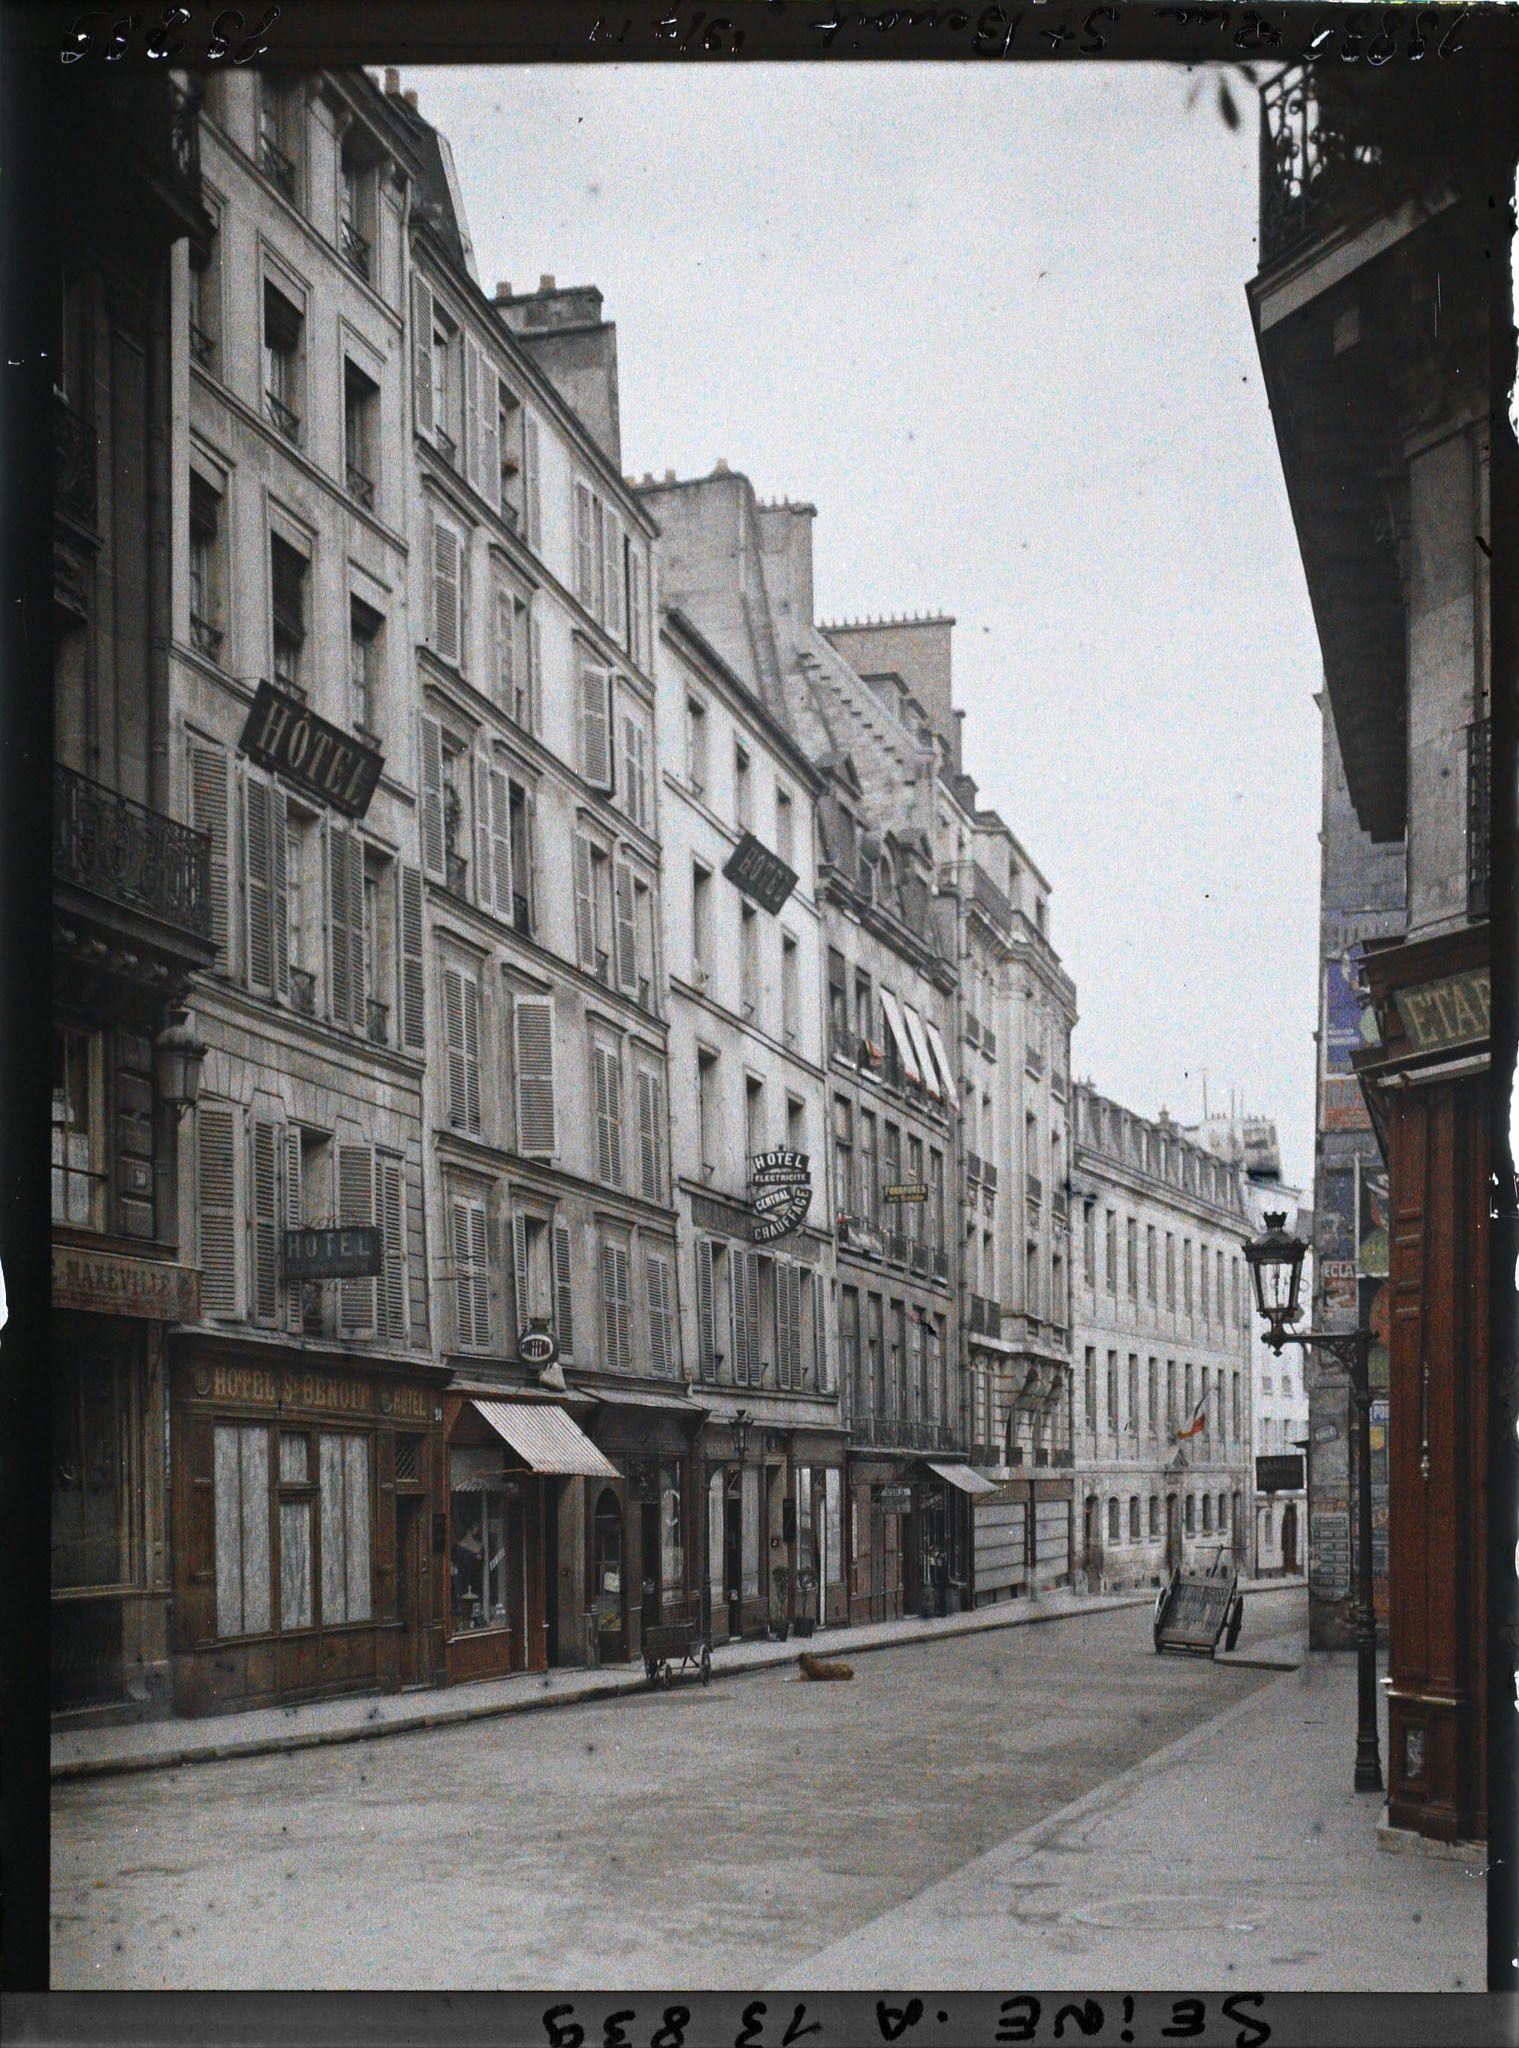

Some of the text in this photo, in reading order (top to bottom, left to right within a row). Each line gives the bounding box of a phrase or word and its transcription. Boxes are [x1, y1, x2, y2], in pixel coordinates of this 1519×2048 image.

[256, 701, 367, 806] HÔTEL
[754, 1152, 803, 1170] HOTEL
[755, 1189, 791, 1211] CENTRAL
[754, 1188, 810, 1241] CHAUFFAGE
[287, 1232, 371, 1258] HOTEL
